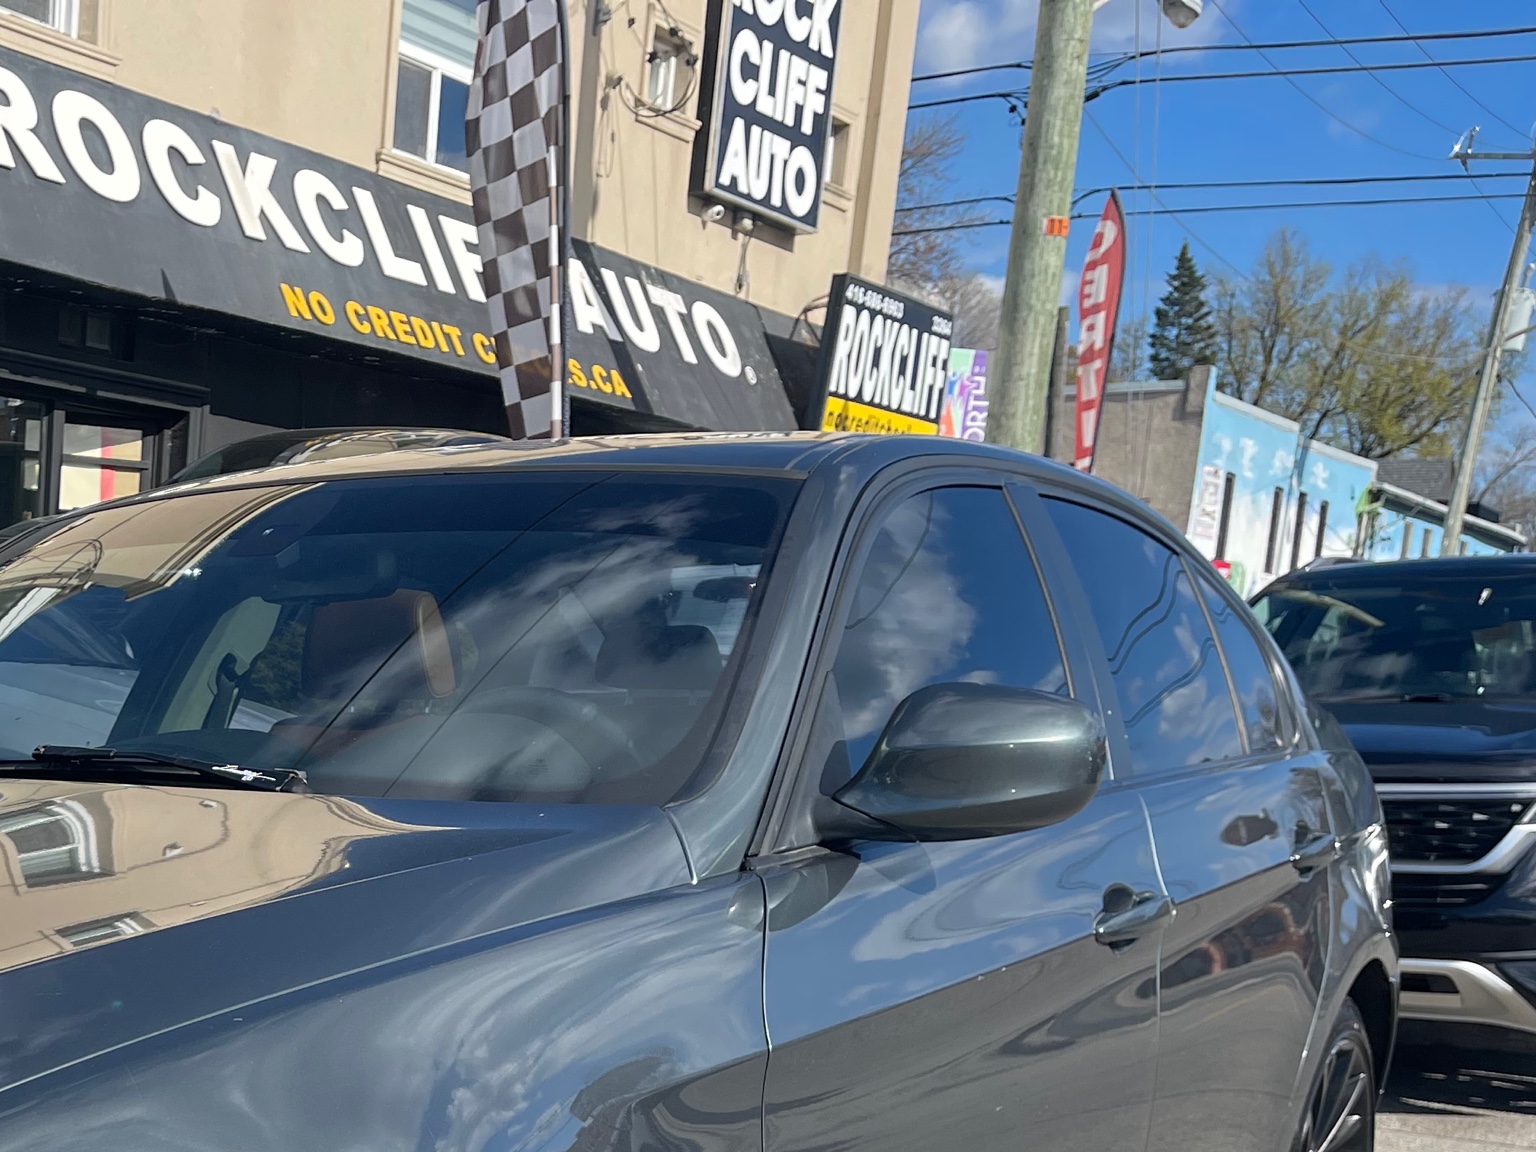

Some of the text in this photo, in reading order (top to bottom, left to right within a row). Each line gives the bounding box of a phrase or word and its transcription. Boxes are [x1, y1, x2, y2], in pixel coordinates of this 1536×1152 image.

[729, 28, 828, 135] CLIFF
[718, 116, 818, 217] AUTO
[279, 282, 335, 326] NO
[345, 299, 465, 357] CREDIT
[828, 303, 951, 420] ROCKCLIFF
